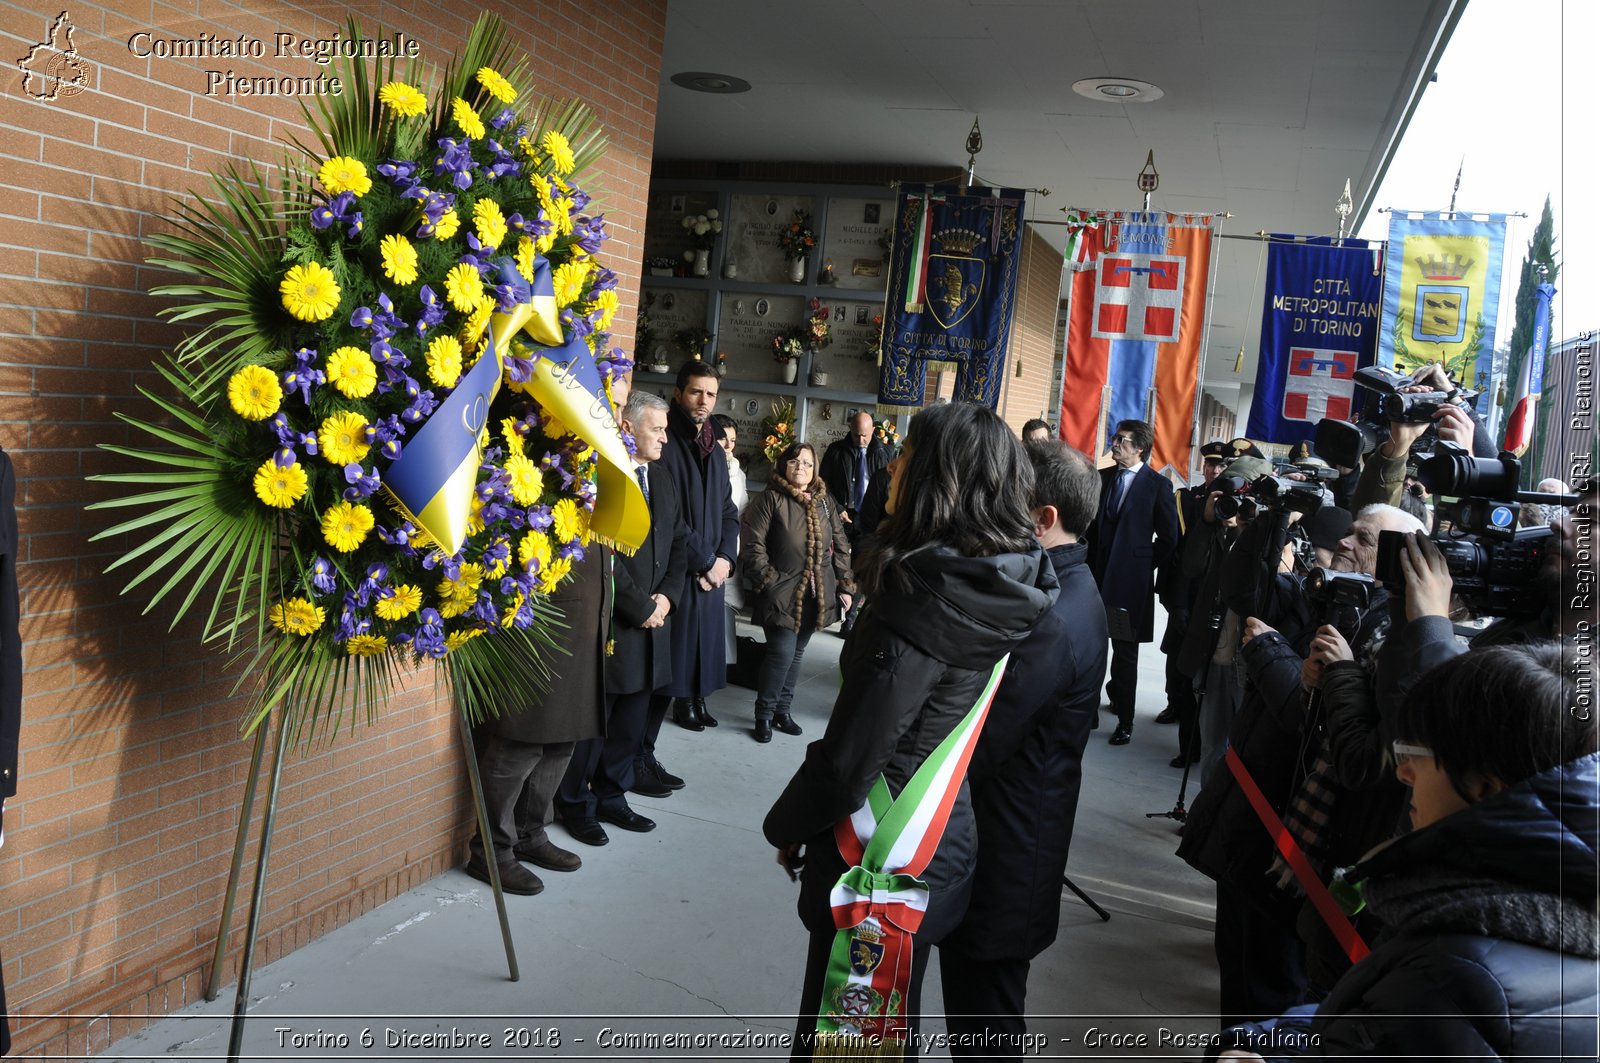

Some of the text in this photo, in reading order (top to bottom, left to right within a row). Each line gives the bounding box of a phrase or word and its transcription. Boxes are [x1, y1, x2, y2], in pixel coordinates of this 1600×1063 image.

[843, 226, 872, 234] MICHELE
[1111, 233, 1176, 249] PIEMONTE
[1447, 233, 1488, 249] NICHELIN
[1313, 277, 1350, 296] CITTÀ
[1272, 295, 1379, 319] METROPOLITAN
[729, 318, 763, 327] TARALLO
[1293, 317, 1362, 338] DI TORINO
[938, 334, 948, 347] DI
[950, 335, 988, 351] TORINO
[1497, 508, 1509, 525] 7
